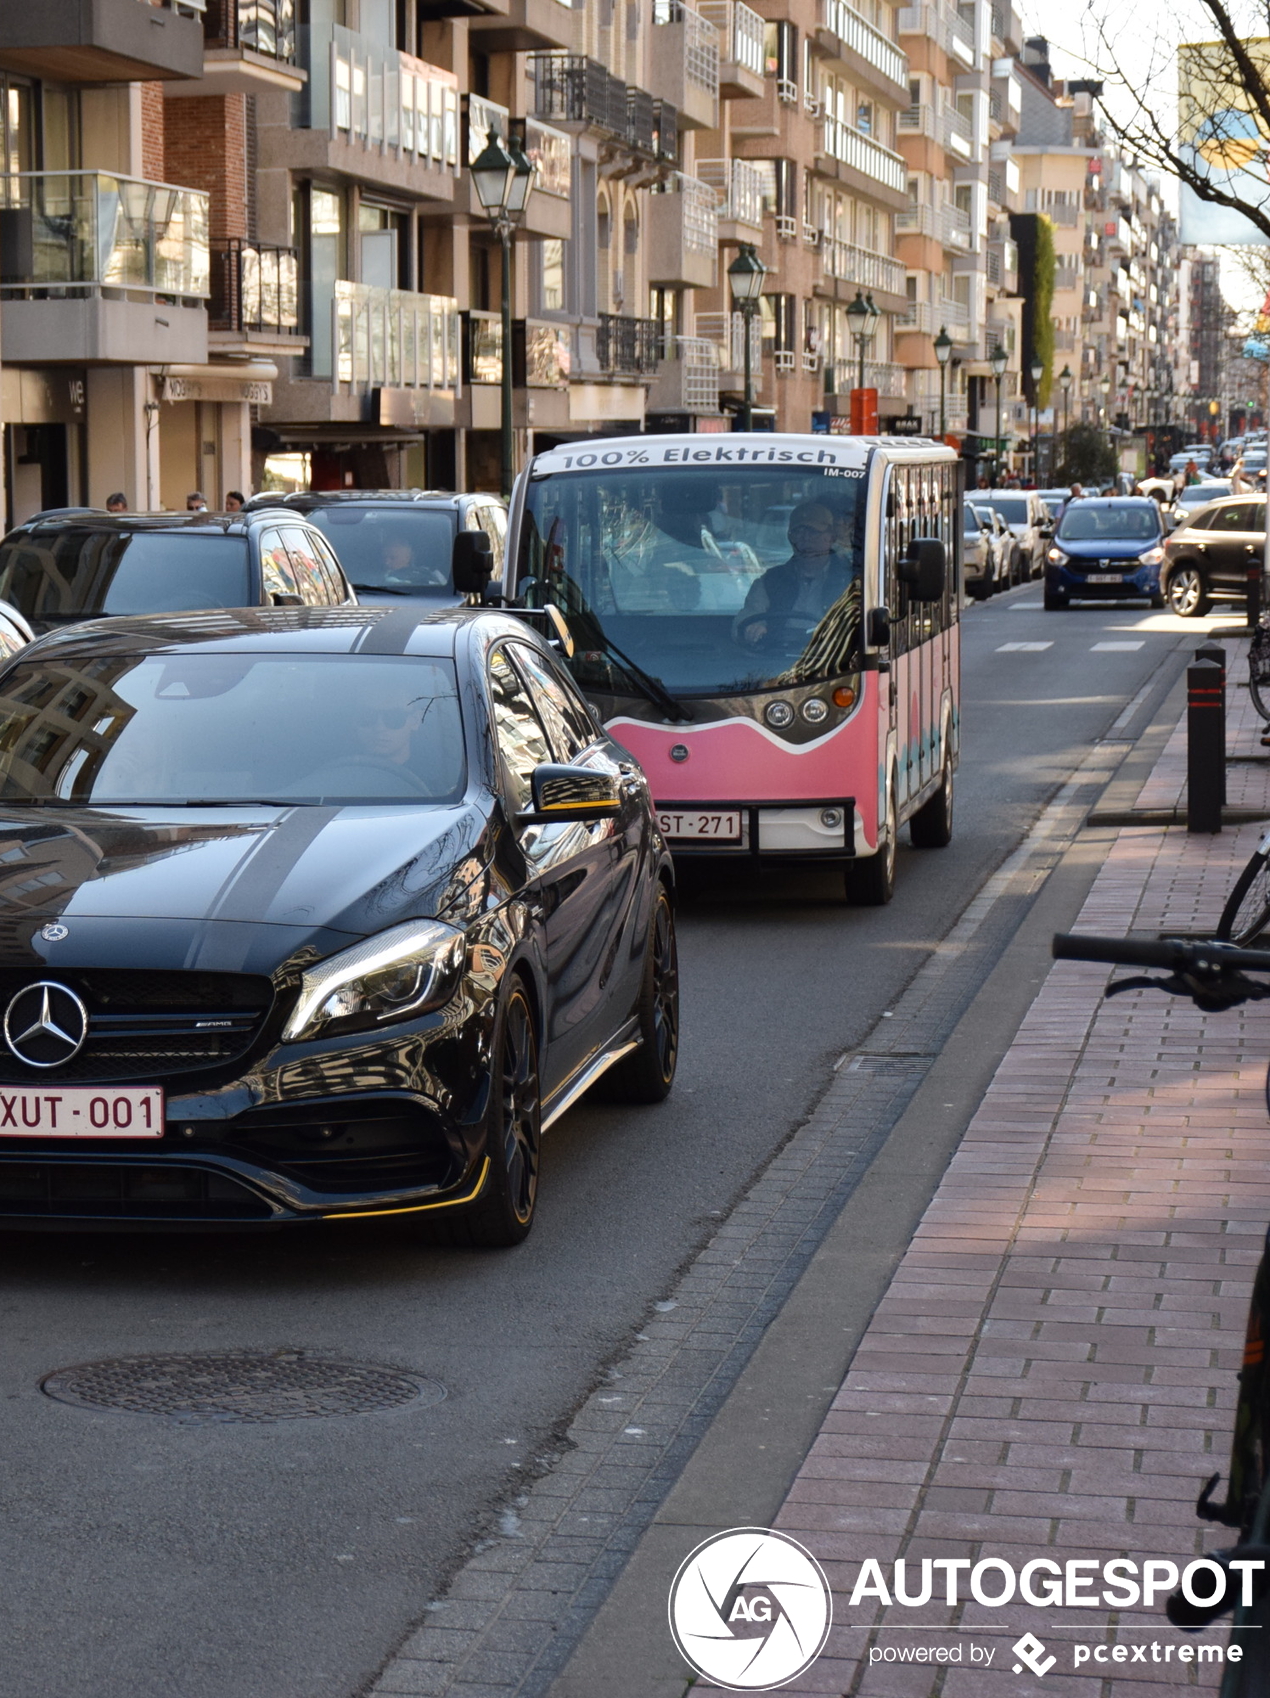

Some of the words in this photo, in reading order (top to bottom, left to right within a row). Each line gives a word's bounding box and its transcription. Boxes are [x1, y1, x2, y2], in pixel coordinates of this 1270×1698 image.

[563, 450, 649, 469] 100%
[663, 446, 837, 464] Elektrisch
[823, 467, 866, 479] IM-007
[655, 814, 734, 834] ST-271
